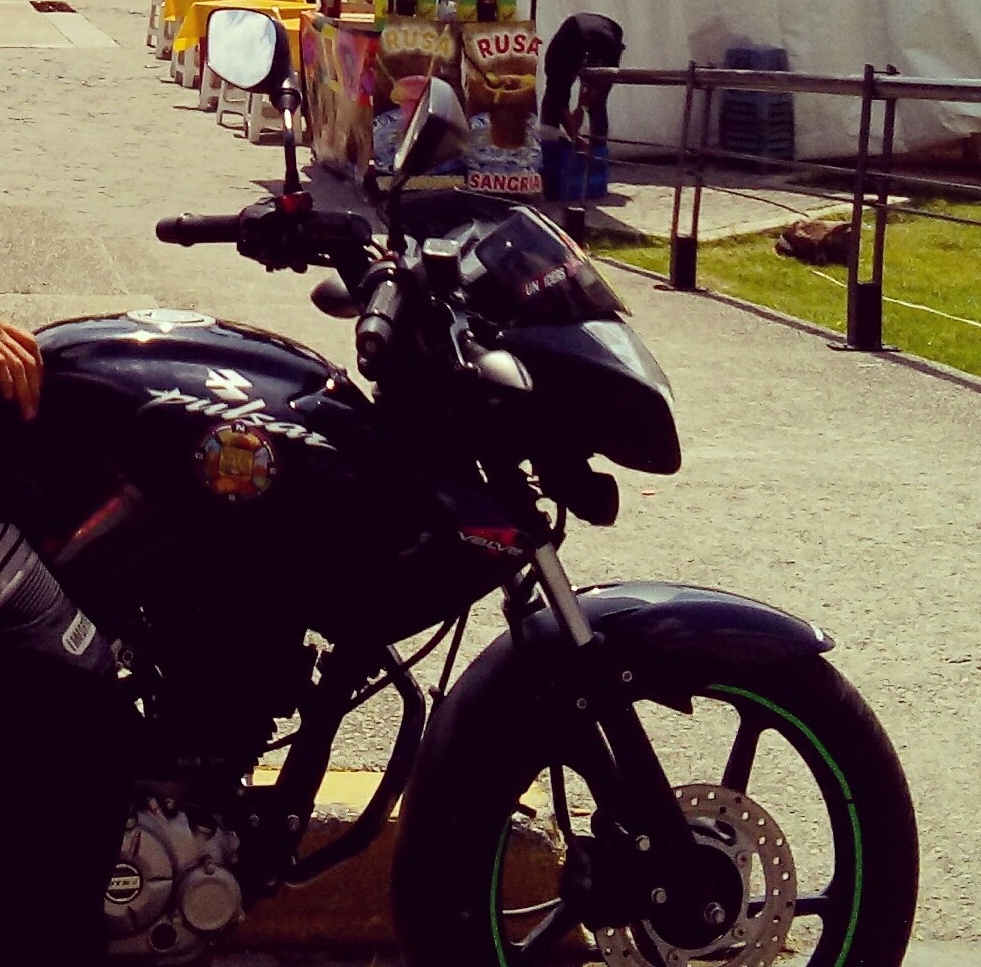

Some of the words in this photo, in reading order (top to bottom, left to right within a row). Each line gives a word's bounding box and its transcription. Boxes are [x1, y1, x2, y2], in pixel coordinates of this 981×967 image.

[384, 27, 452, 58] RUSA
[477, 33, 543, 59] RUSA
[469, 173, 542, 192] SANGRIA
